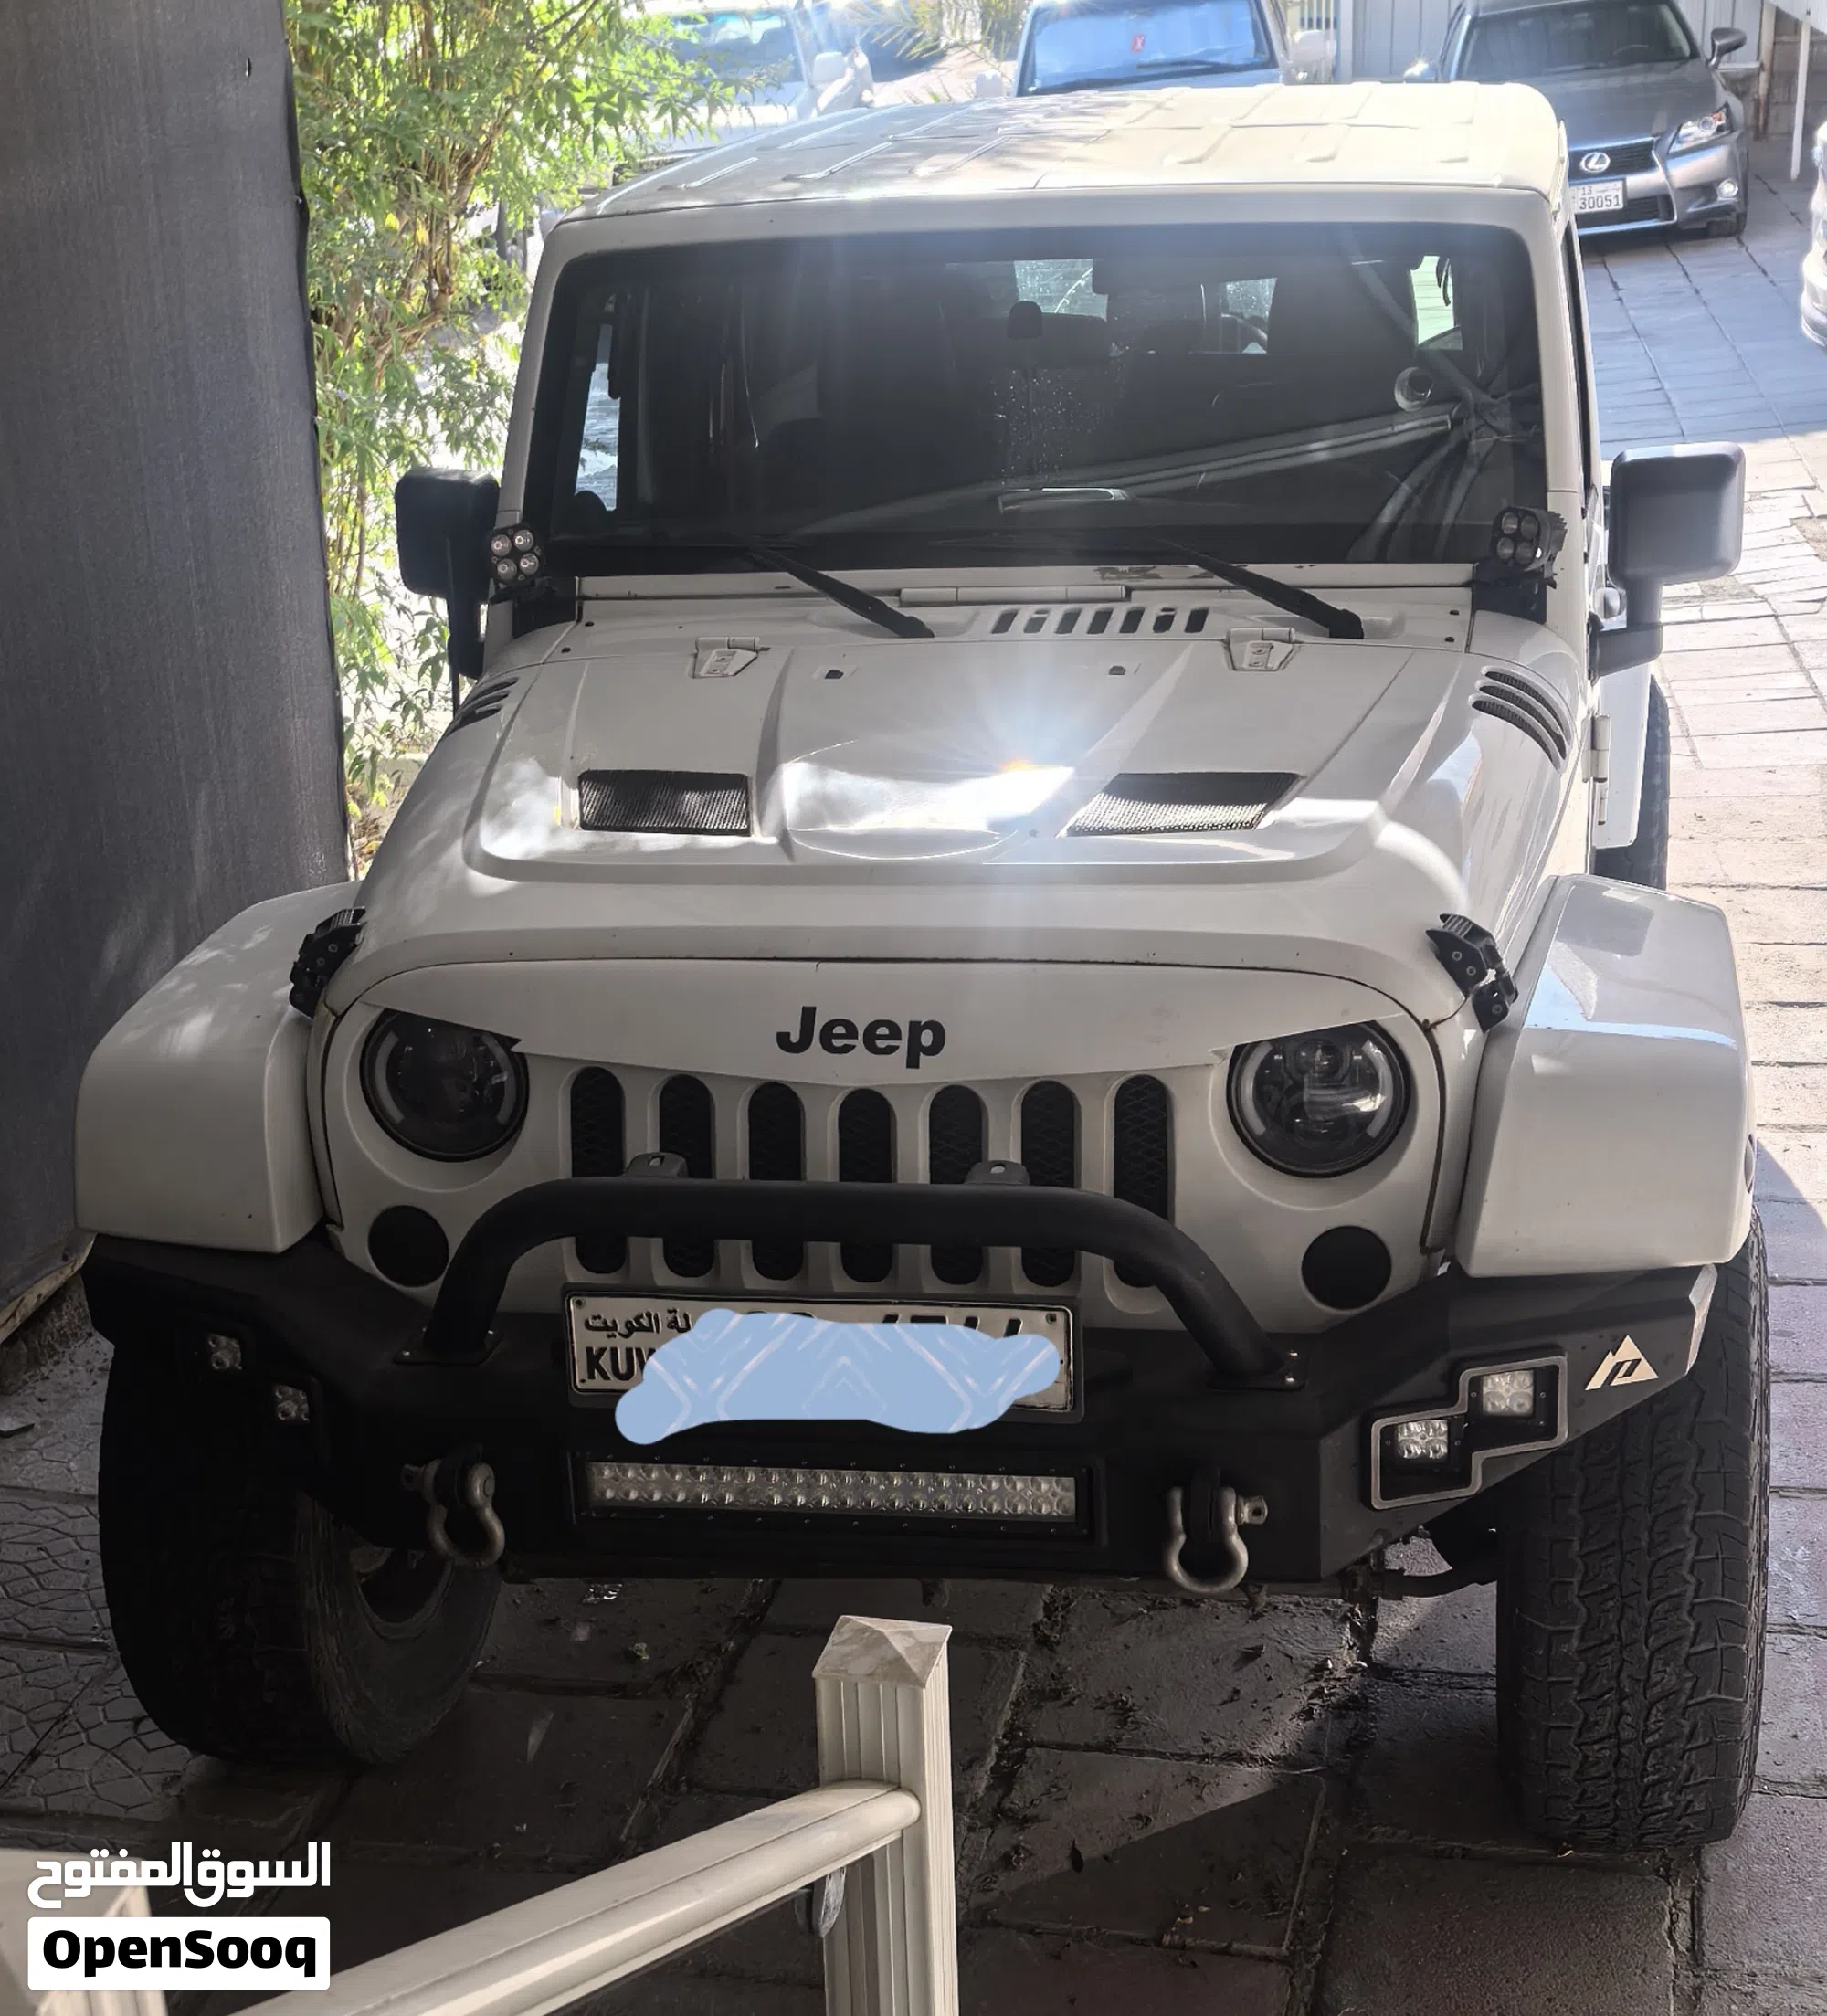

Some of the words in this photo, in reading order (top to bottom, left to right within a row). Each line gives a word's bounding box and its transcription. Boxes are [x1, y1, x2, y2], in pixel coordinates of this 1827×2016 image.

[1579, 194, 1621, 210] 30051
[776, 1006, 945, 1069] Jeep
[585, 1311, 661, 1339] الكويت
